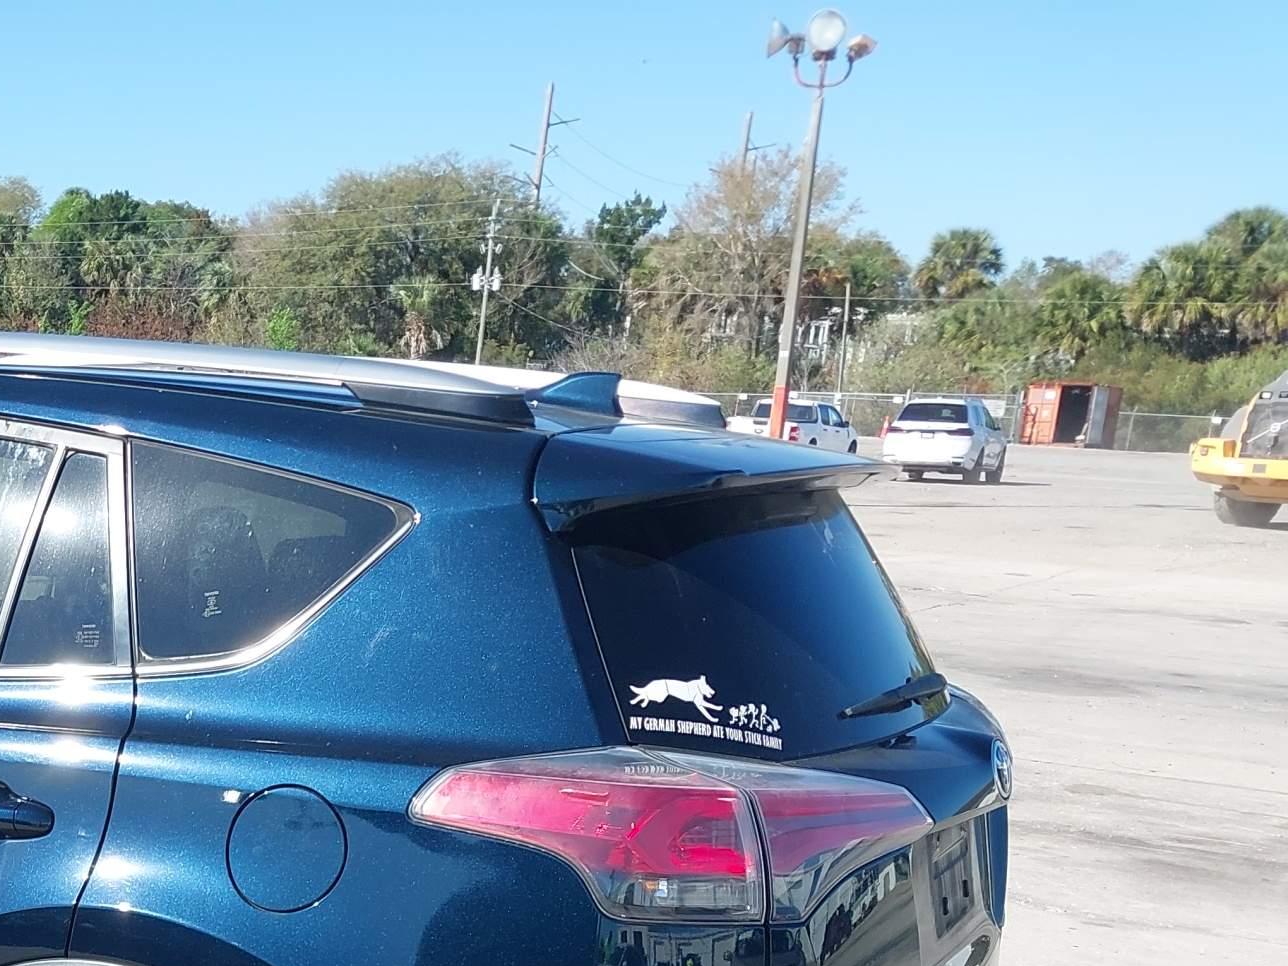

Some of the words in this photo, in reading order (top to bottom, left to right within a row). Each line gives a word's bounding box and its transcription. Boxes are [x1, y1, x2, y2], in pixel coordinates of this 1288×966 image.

[629, 716, 643, 730] MY
[643, 717, 676, 733] GERMAN
[677, 721, 712, 736] SHEPHERD
[713, 724, 725, 739] ATE
[725, 726, 744, 742] YOUR
[744, 730, 762, 746] STICK
